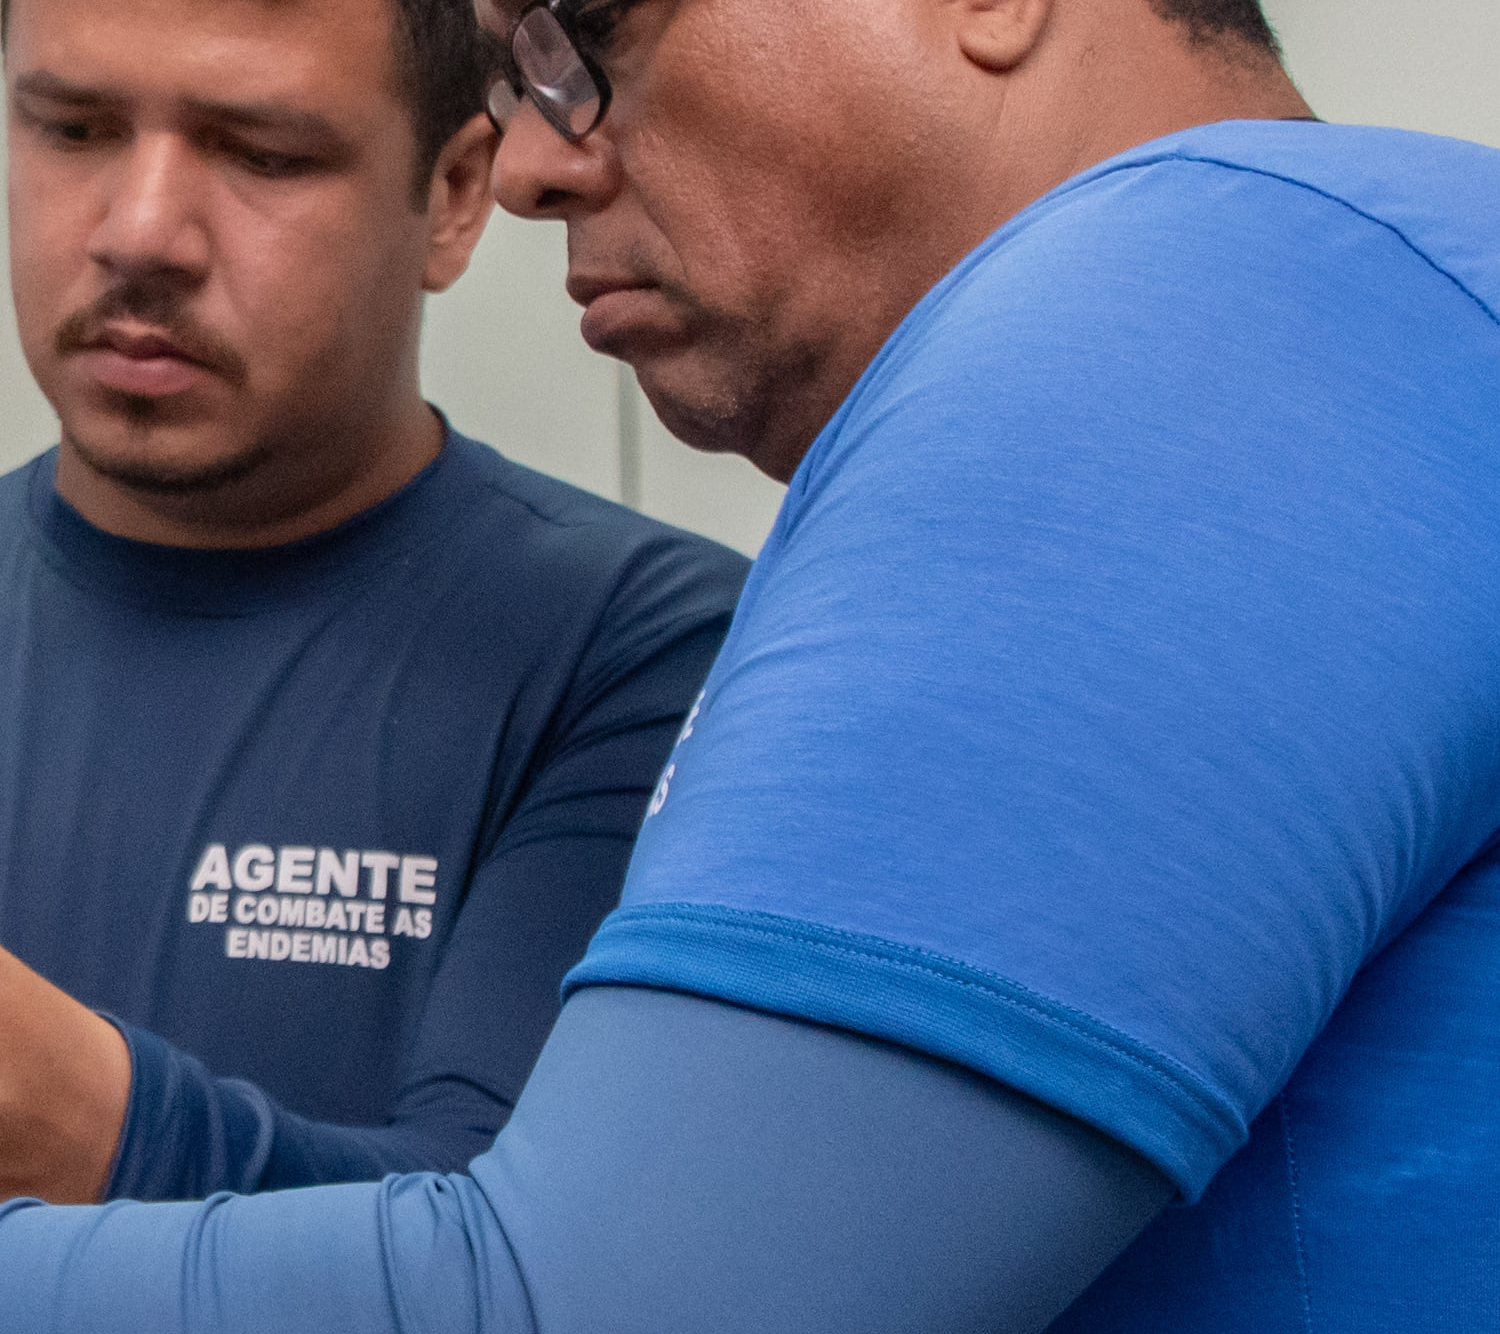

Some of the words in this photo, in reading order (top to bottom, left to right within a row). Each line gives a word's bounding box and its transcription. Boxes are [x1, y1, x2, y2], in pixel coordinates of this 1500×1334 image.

[191, 843, 438, 904] AGENTE
[190, 893, 229, 923] DE
[234, 895, 386, 934] COMBATE
[392, 907, 433, 939] AS
[227, 929, 391, 970] ENDEMIAS
